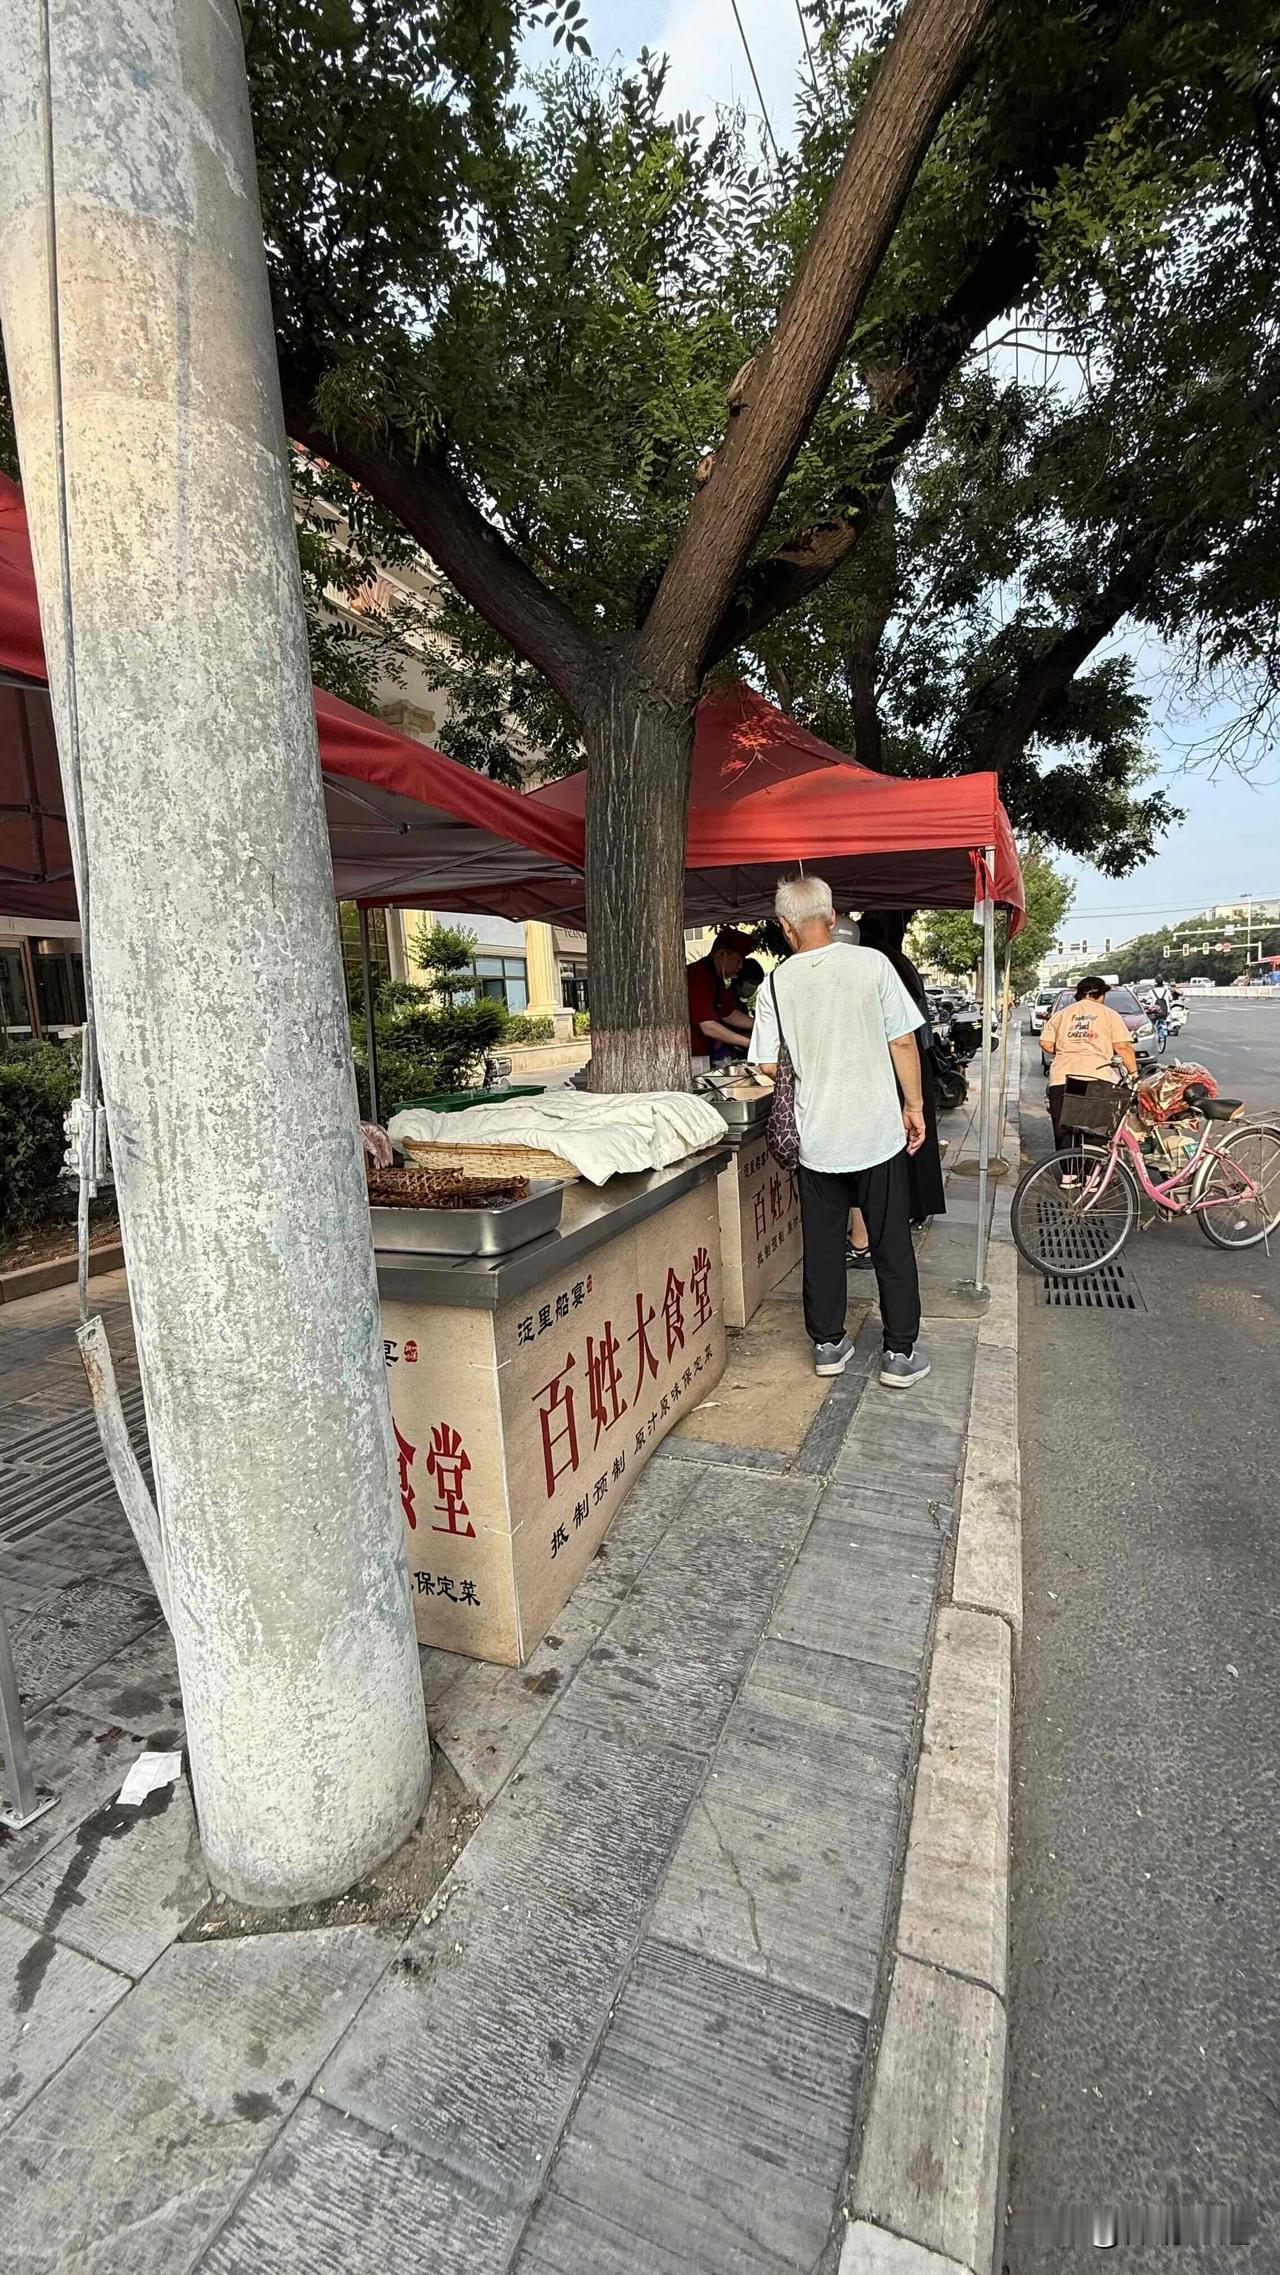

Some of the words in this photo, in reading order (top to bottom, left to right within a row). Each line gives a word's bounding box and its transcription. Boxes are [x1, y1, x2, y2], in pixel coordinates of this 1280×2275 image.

[518, 1281, 585, 1345] 淀里船宴
[532, 1247, 713, 1498] 百姓大食堂
[551, 1450, 625, 1558] 抵制预制
[634, 1344, 712, 1455] 原汁原味保定菜
[411, 1571, 480, 1606] 保定菜
